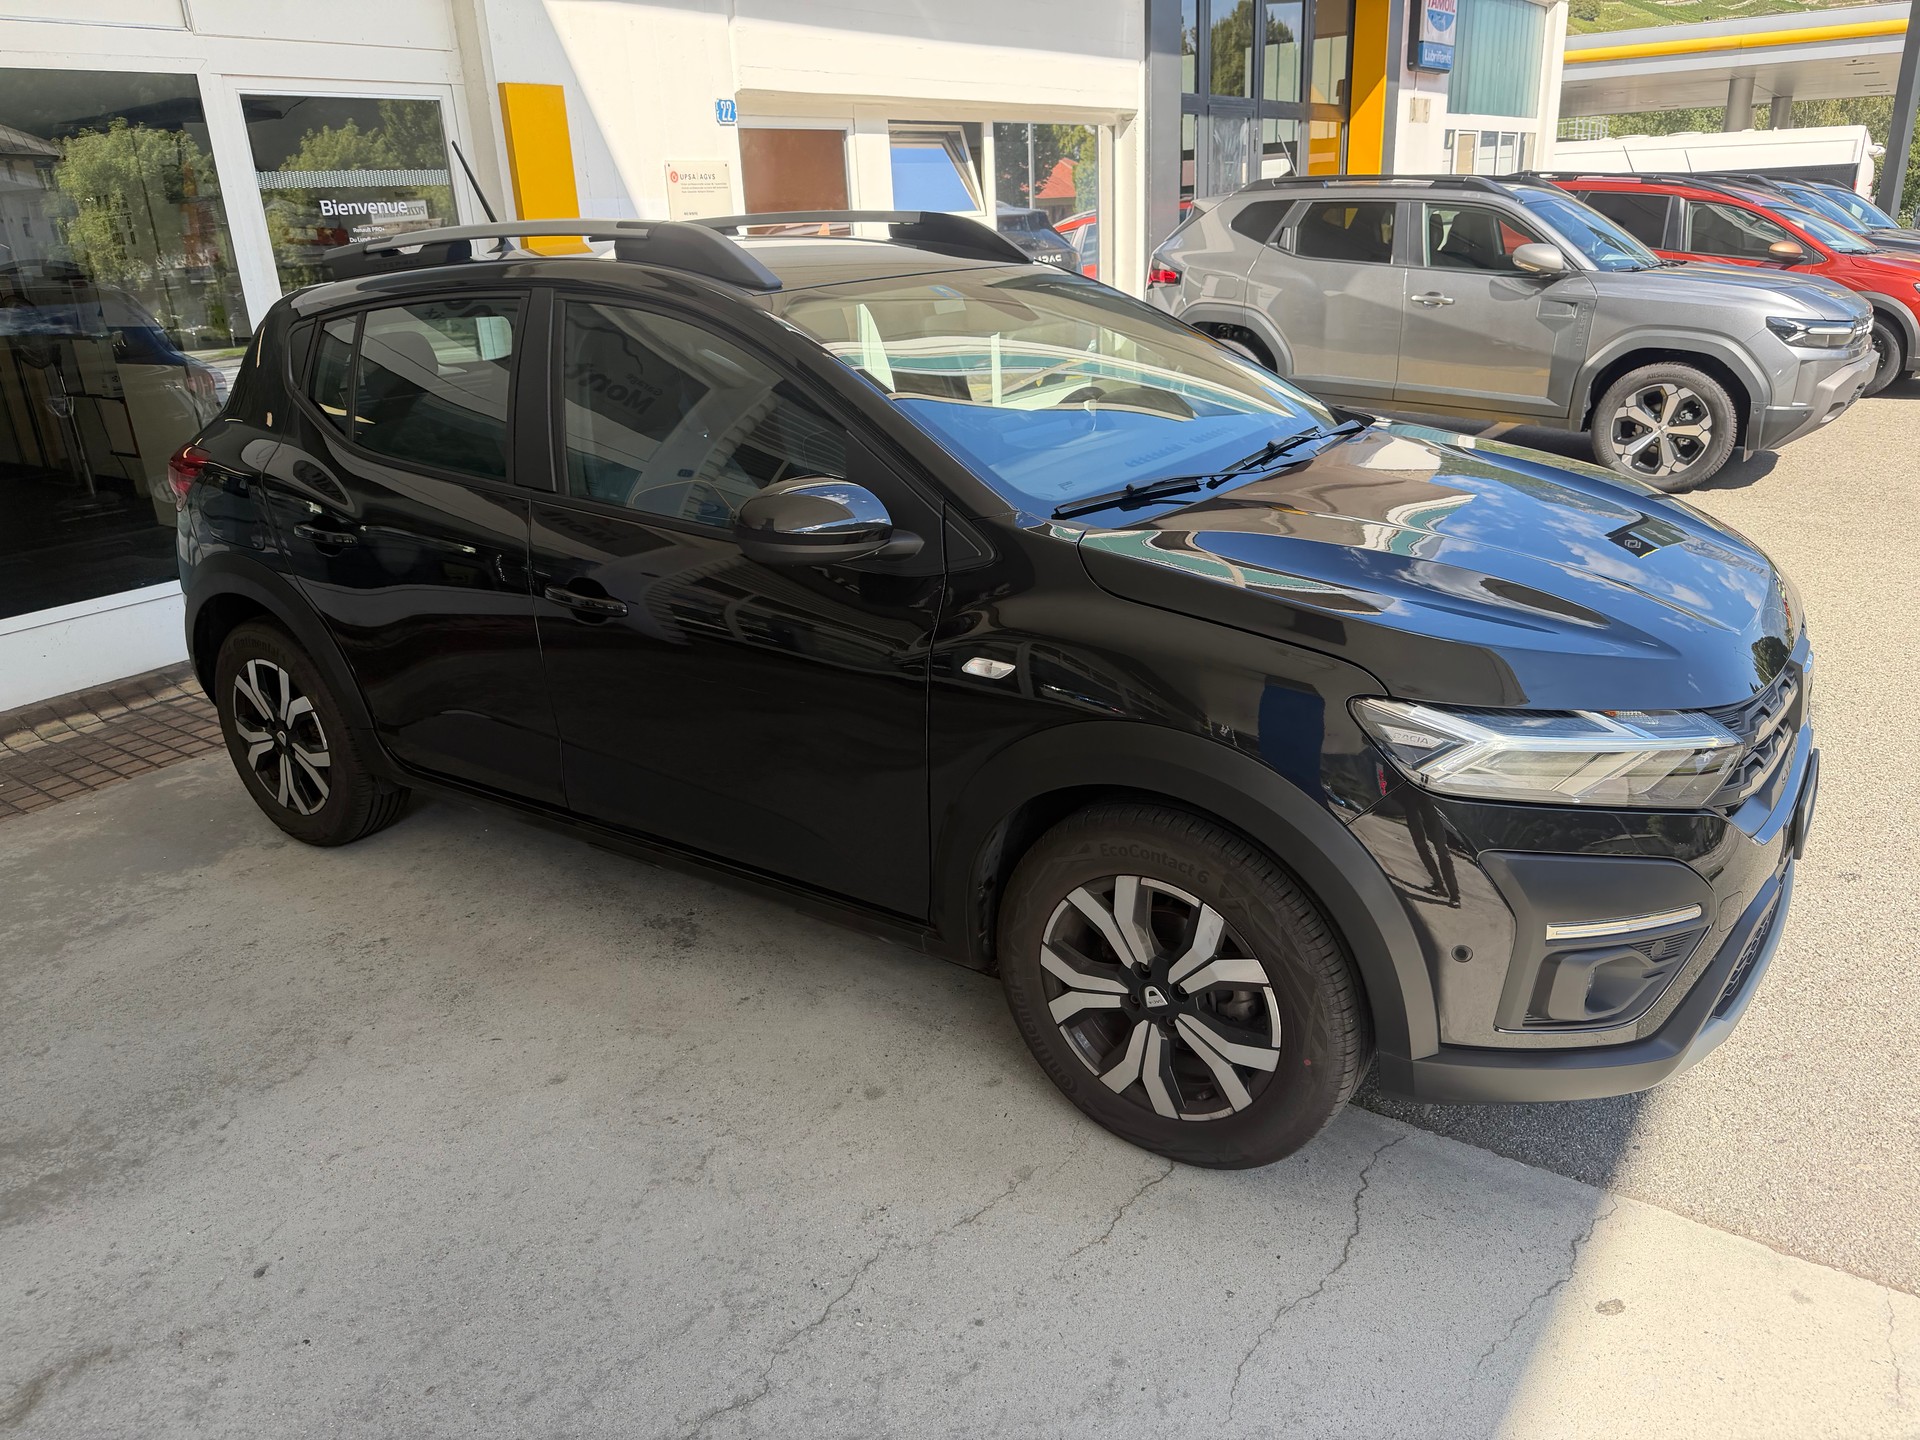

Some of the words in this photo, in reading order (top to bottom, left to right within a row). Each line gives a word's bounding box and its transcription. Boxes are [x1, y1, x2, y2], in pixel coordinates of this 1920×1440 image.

[720, 101, 733, 121] 22
[680, 173, 696, 181] UPSA
[319, 200, 408, 216] Bienvenue
[1646, 372, 1707, 390] AllSeasonContact
[1101, 843, 1195, 878] EcoContact
[1199, 870, 1211, 885] 6
